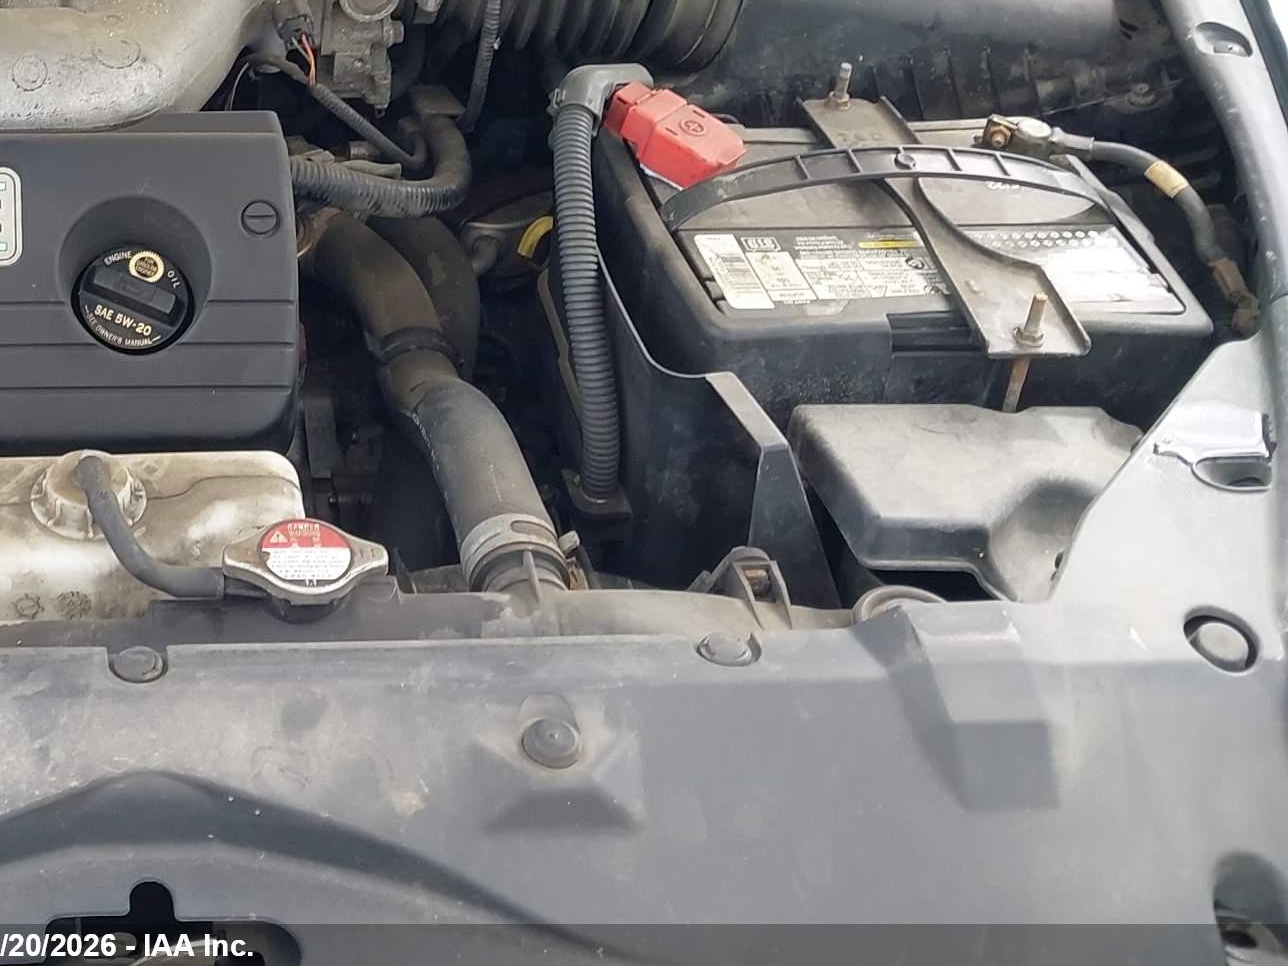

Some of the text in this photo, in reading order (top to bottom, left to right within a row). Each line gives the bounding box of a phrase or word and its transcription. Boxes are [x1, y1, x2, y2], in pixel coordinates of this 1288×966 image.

[103, 250, 181, 289] ENGINE OIL
[94, 304, 153, 337] SAE 5W-20
[124, 337, 153, 347] MANUAL
